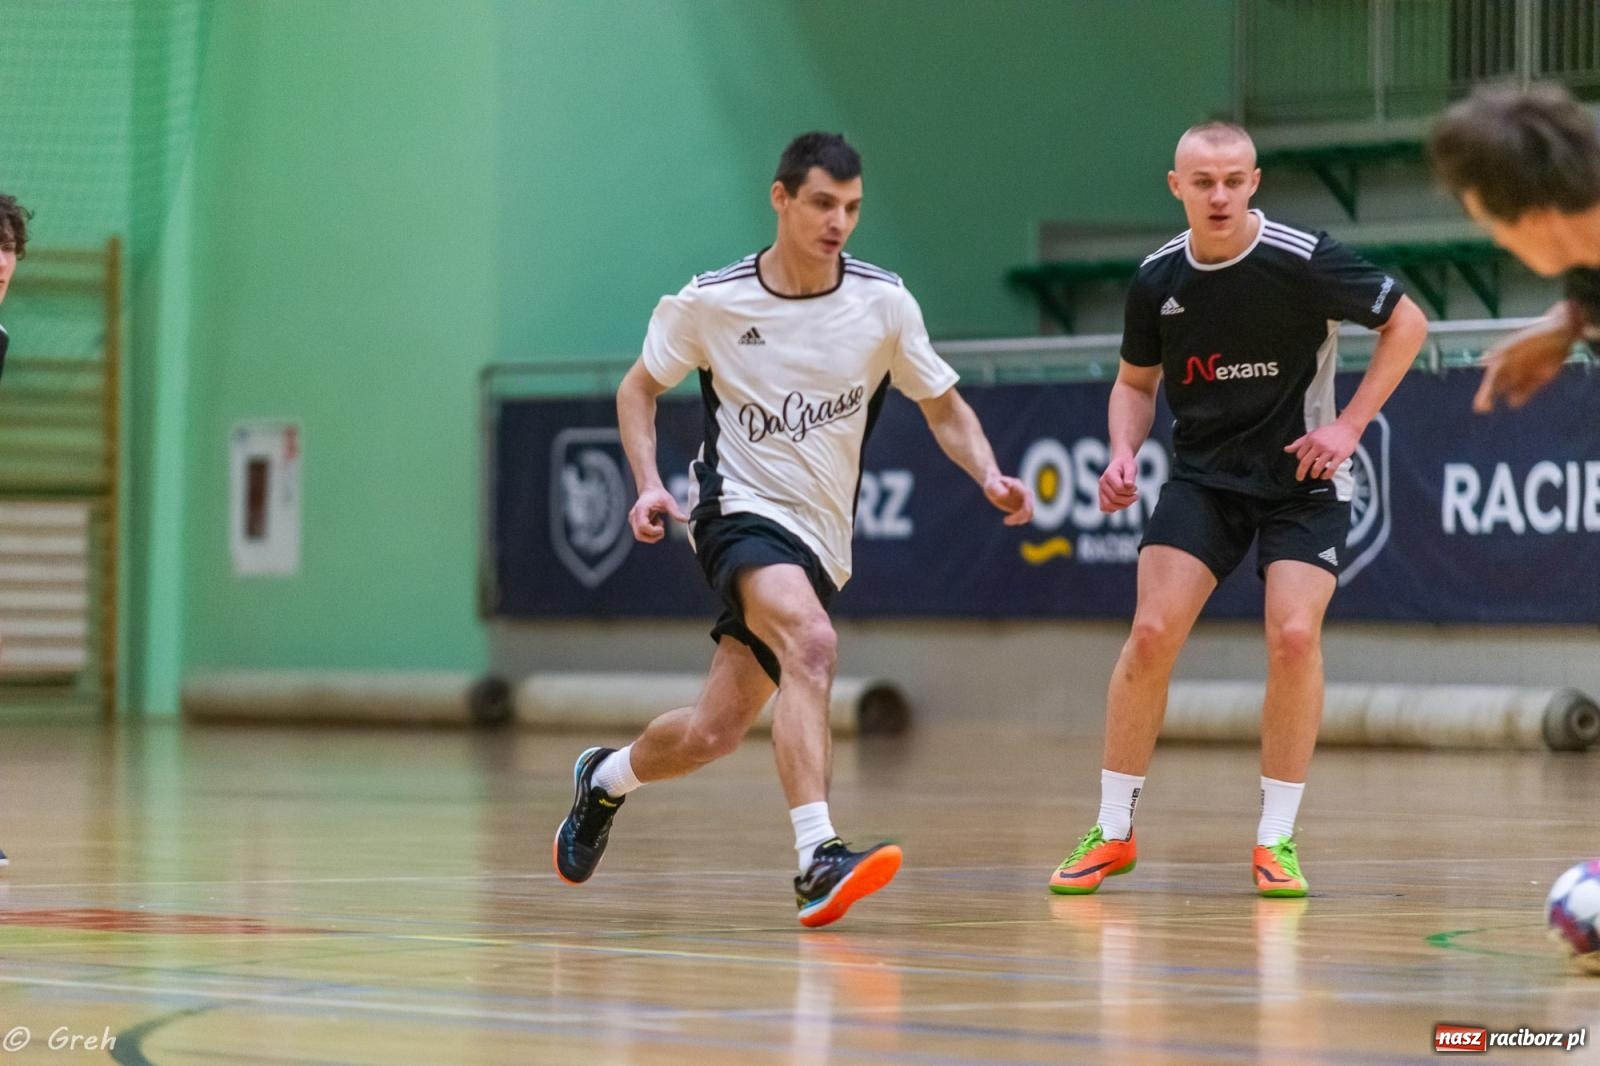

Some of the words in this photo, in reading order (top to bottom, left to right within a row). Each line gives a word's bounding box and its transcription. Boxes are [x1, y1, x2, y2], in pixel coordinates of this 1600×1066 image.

[1181, 353, 1280, 385] Nexans
[739, 384, 864, 443] DaGrasso
[1020, 437, 1169, 529] OSR
